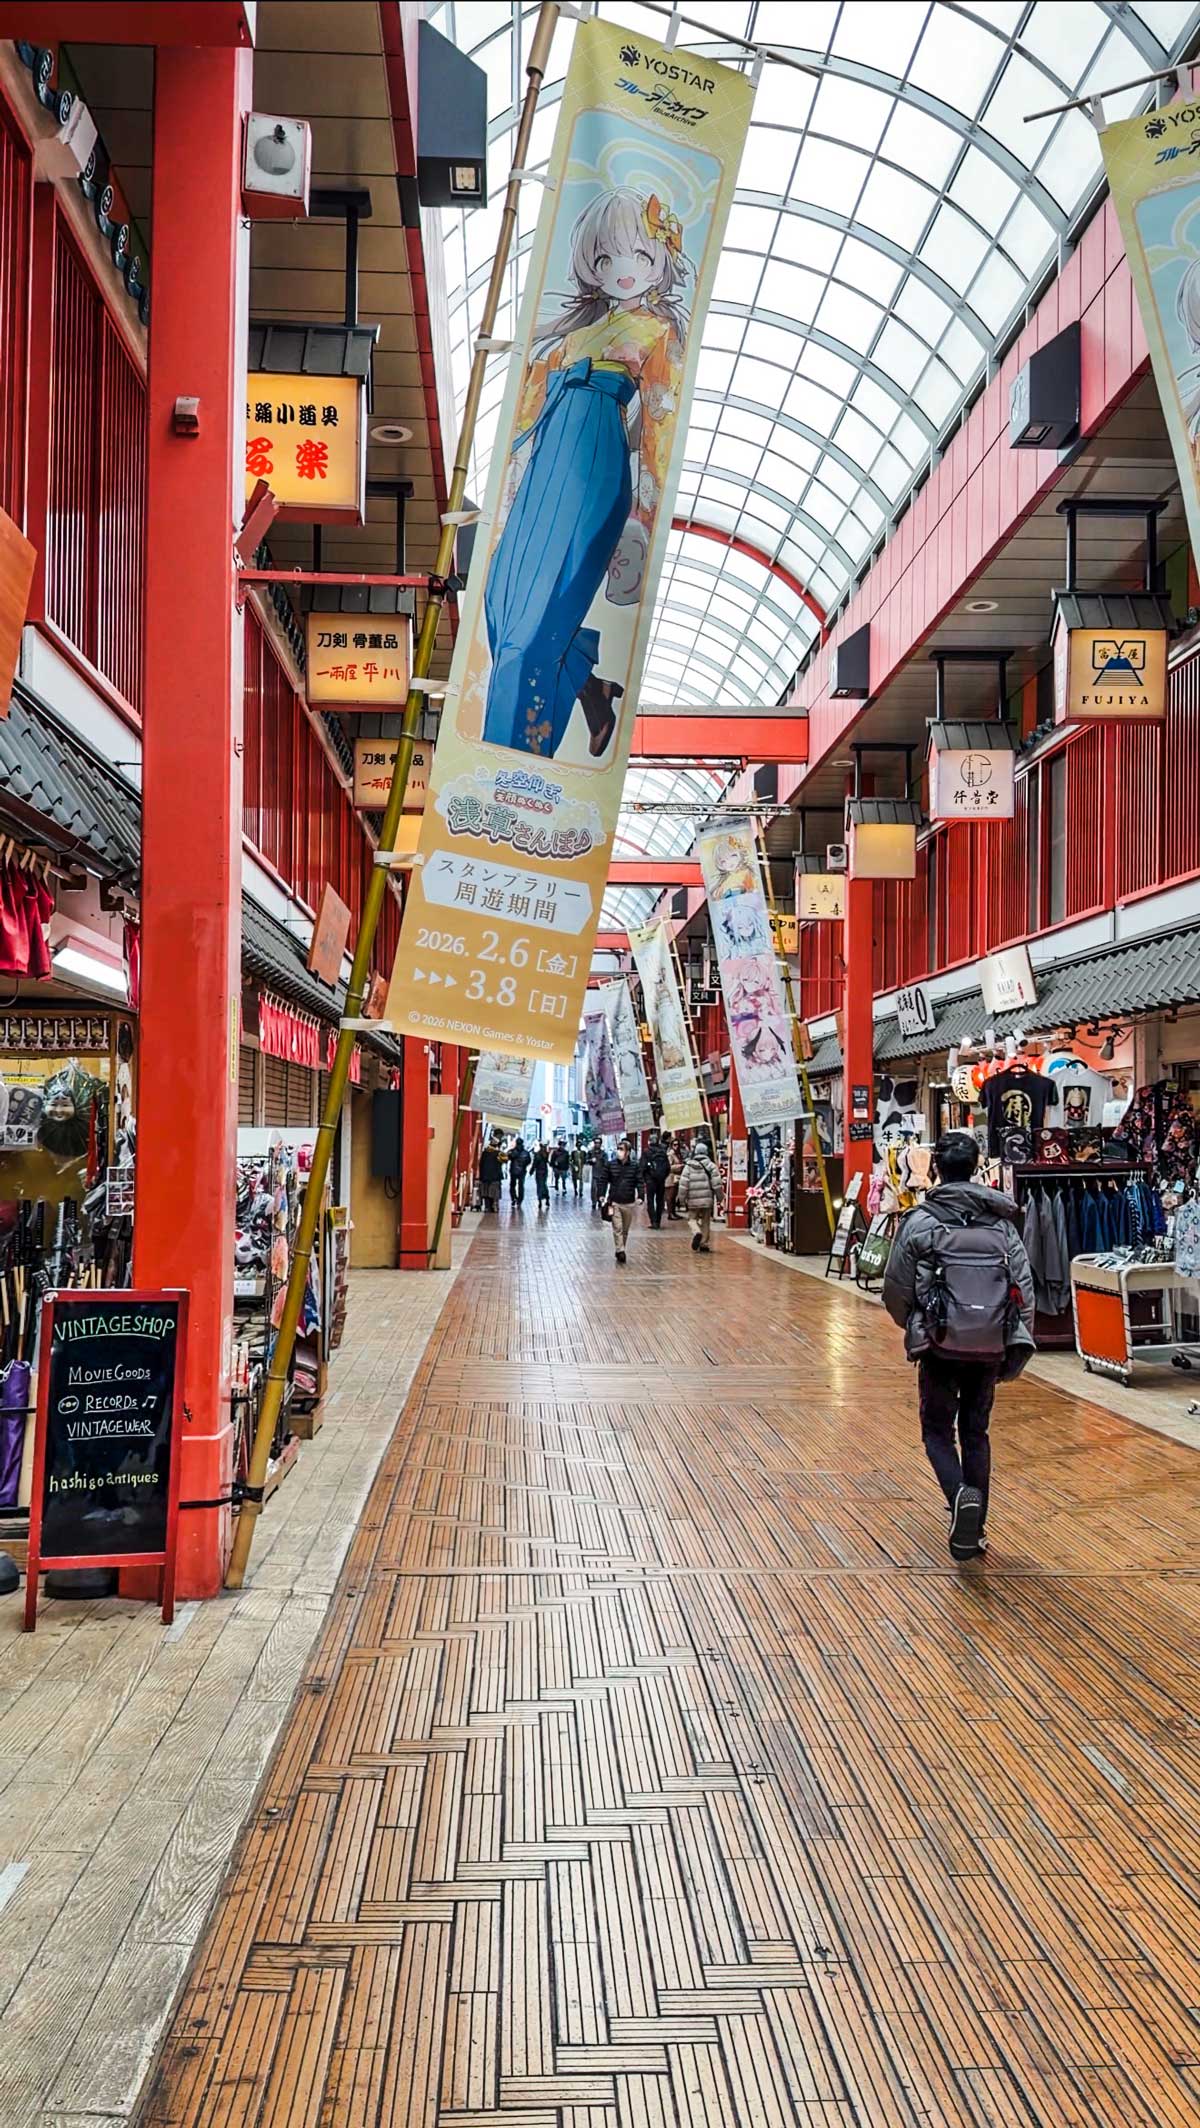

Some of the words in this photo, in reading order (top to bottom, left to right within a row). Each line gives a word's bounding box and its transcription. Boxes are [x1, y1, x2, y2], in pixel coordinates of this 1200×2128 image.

[644, 56, 715, 94] YOSTAR
[614, 78, 709, 120] ブルーアーカイブ
[246, 402, 339, 427] 踊小道具
[317, 632, 347, 648] 刀剣
[353, 633, 398, 649] 骨董品
[1082, 695, 1149, 705] FUJIYA
[361, 753, 386, 765] 刀剣
[438, 859, 582, 898] スタンプラリー
[454, 880, 557, 924] 周遊期間
[415, 928, 469, 958] 2026.
[477, 930, 530, 968] 2.6
[465, 970, 517, 1007] 3.8
[422, 1014, 445, 1027] 2026
[447, 1020, 480, 1036] NEXON
[481, 1027, 515, 1042] Games
[525, 1035, 555, 1050] Yostar
